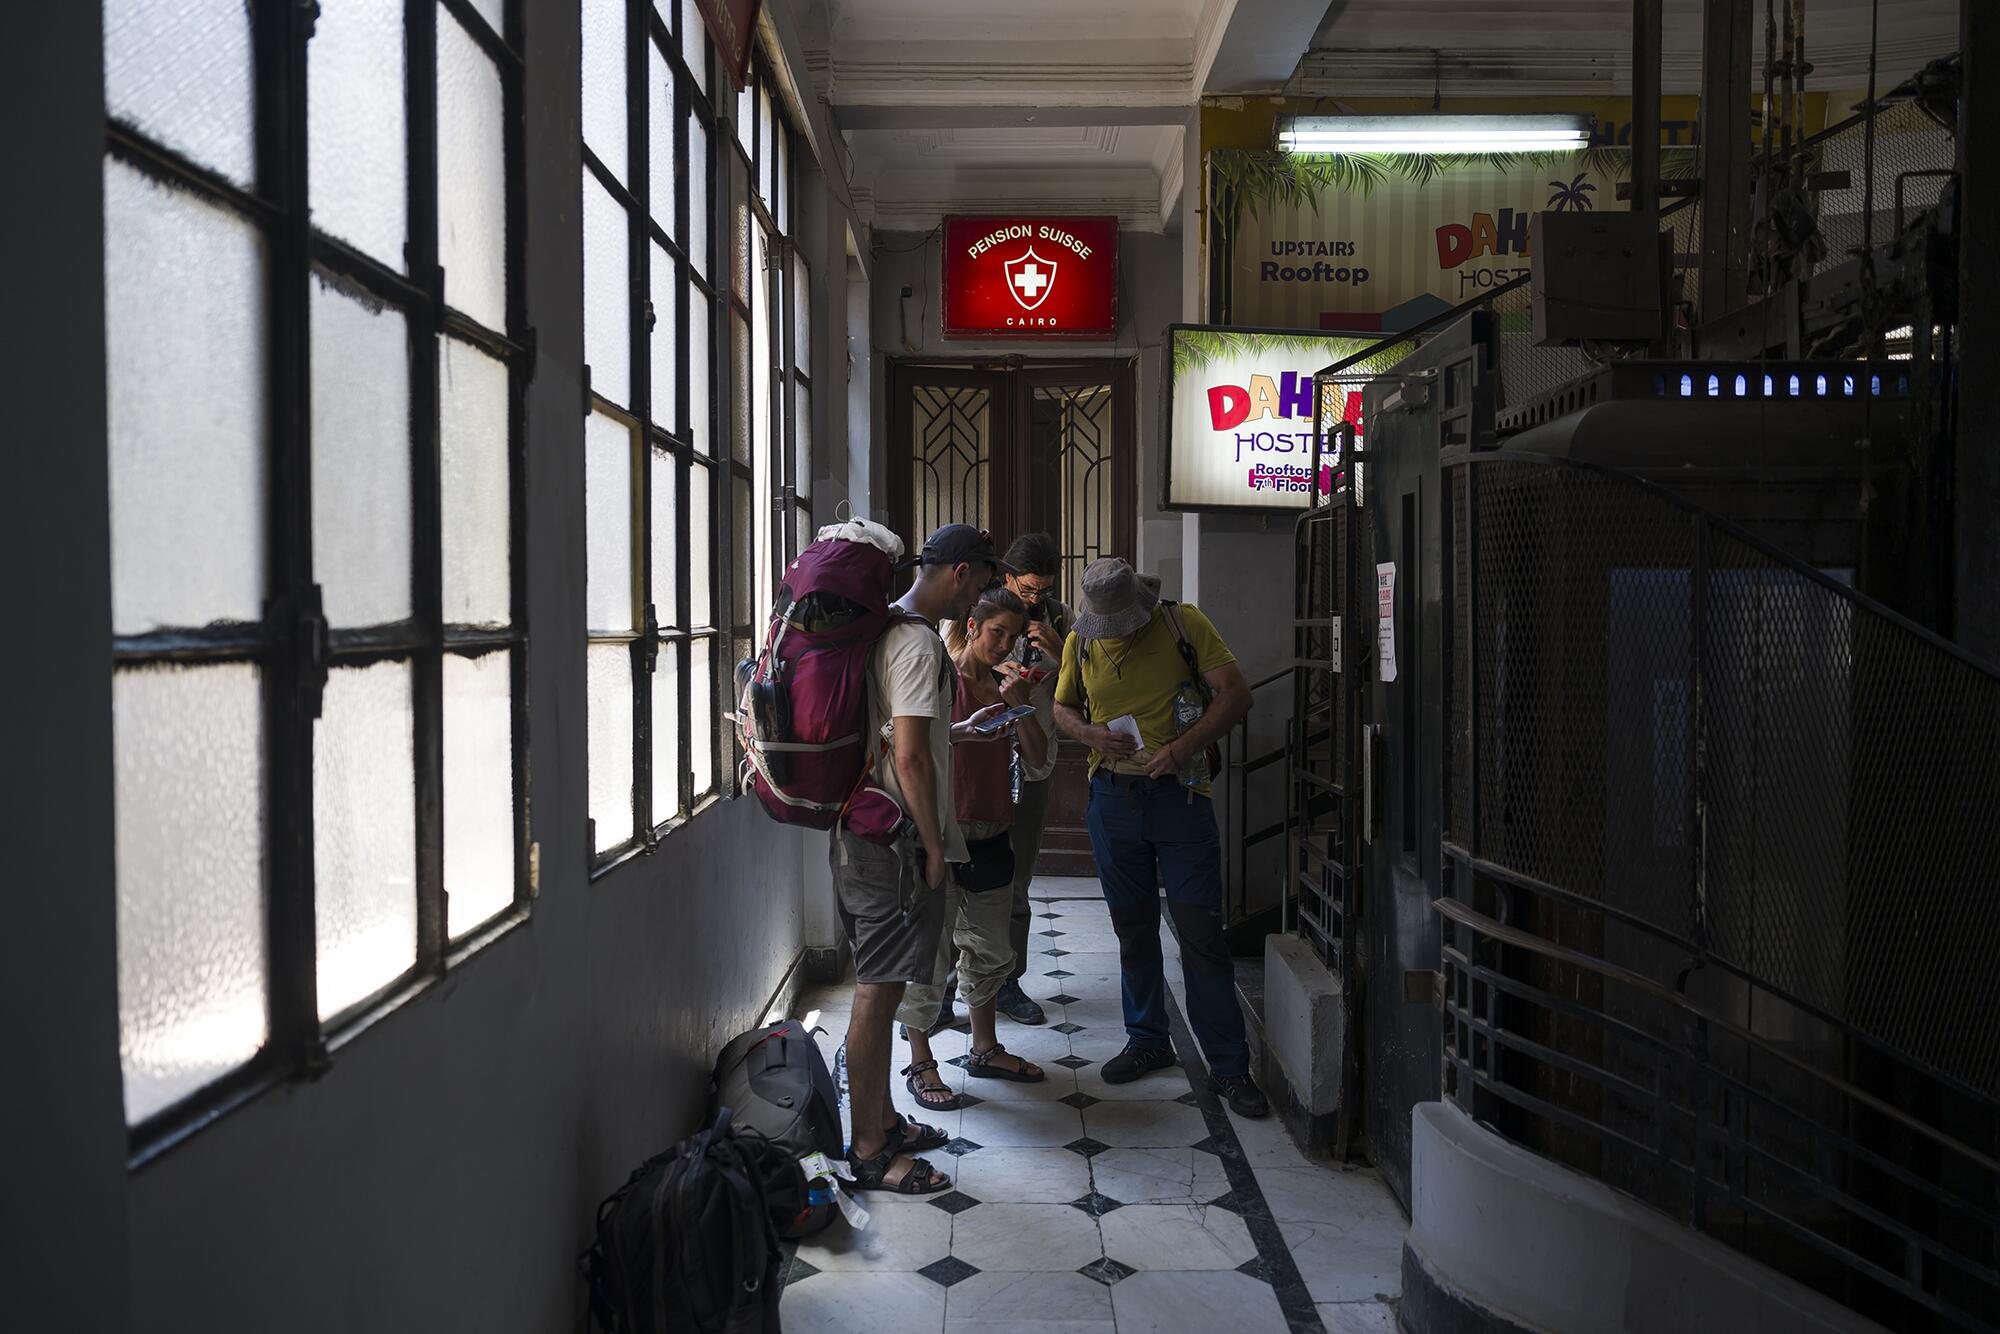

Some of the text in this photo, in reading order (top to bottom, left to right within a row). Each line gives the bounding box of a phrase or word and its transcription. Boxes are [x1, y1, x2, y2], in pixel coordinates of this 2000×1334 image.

[967, 225, 1092, 260] PENSION SUISSE
[1271, 241, 1355, 256] UPSTAIRS
[1261, 261, 1369, 286] Rooftop
[1006, 317, 1057, 326] CAIRO
[1256, 463, 1312, 478] Rooftop
[1255, 479, 1272, 491] 7th
